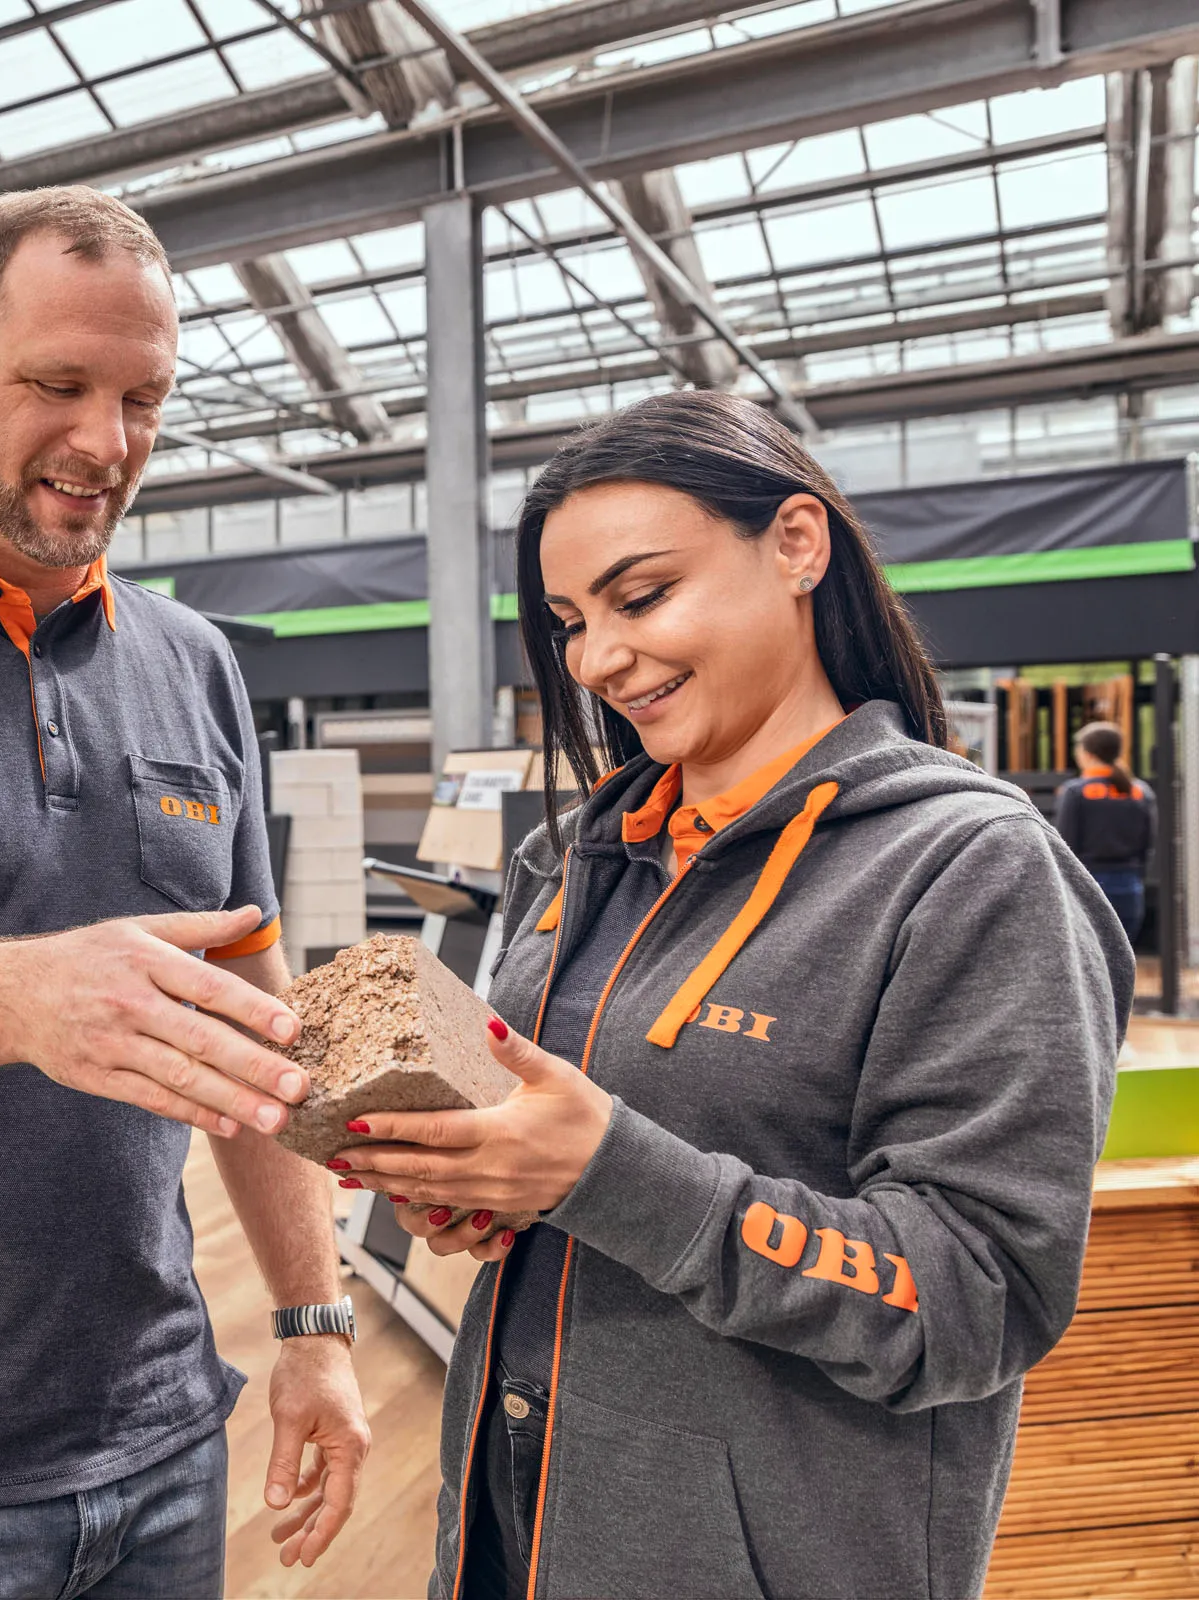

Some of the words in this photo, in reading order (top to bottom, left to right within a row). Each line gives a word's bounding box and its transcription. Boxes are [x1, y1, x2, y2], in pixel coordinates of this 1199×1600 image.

[160, 795, 220, 825] OBI
[685, 1003, 777, 1042] BI
[741, 1201, 919, 1312] OBI
